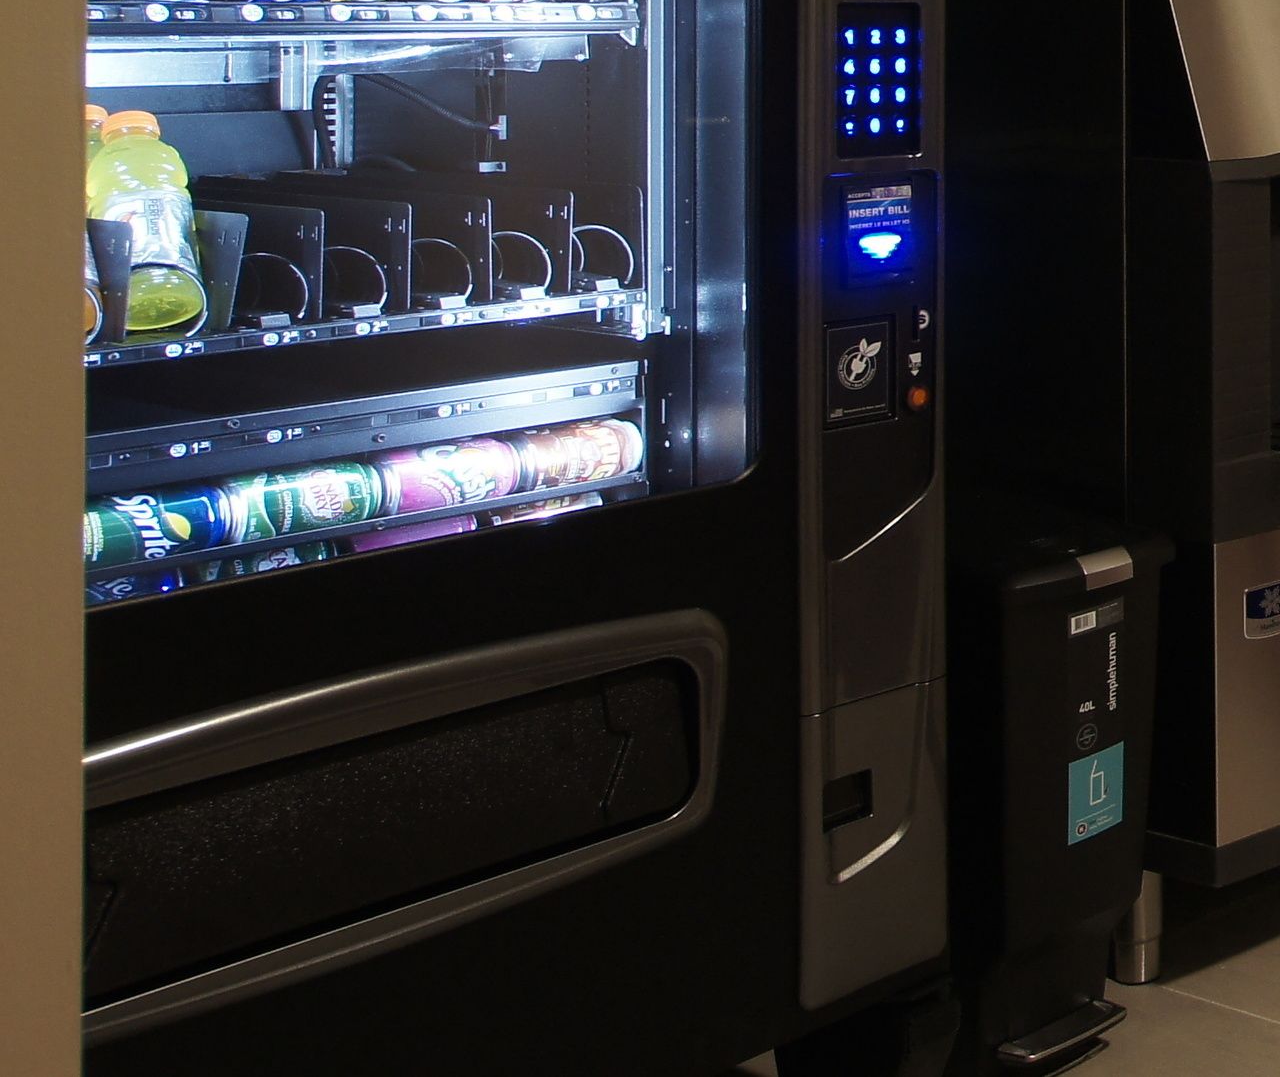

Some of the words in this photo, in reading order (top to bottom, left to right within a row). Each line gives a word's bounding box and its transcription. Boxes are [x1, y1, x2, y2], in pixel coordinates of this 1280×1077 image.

[175, 9, 196, 20] 1.50
[276, 9, 295, 20] 1.50
[845, 29, 854, 44] 1
[870, 29, 880, 44] 2
[895, 29, 905, 44] 3
[844, 59, 855, 74] 4
[845, 89, 855, 105] 7
[848, 207, 885, 219] INSERT
[888, 205, 910, 215] BILL
[310, 469, 344, 521] CNADA
[310, 484, 329, 511] DRY
[111, 494, 180, 560] Sprite
[1107, 631, 1119, 711] simplehuman
[1078, 701, 1096, 713] 40L
